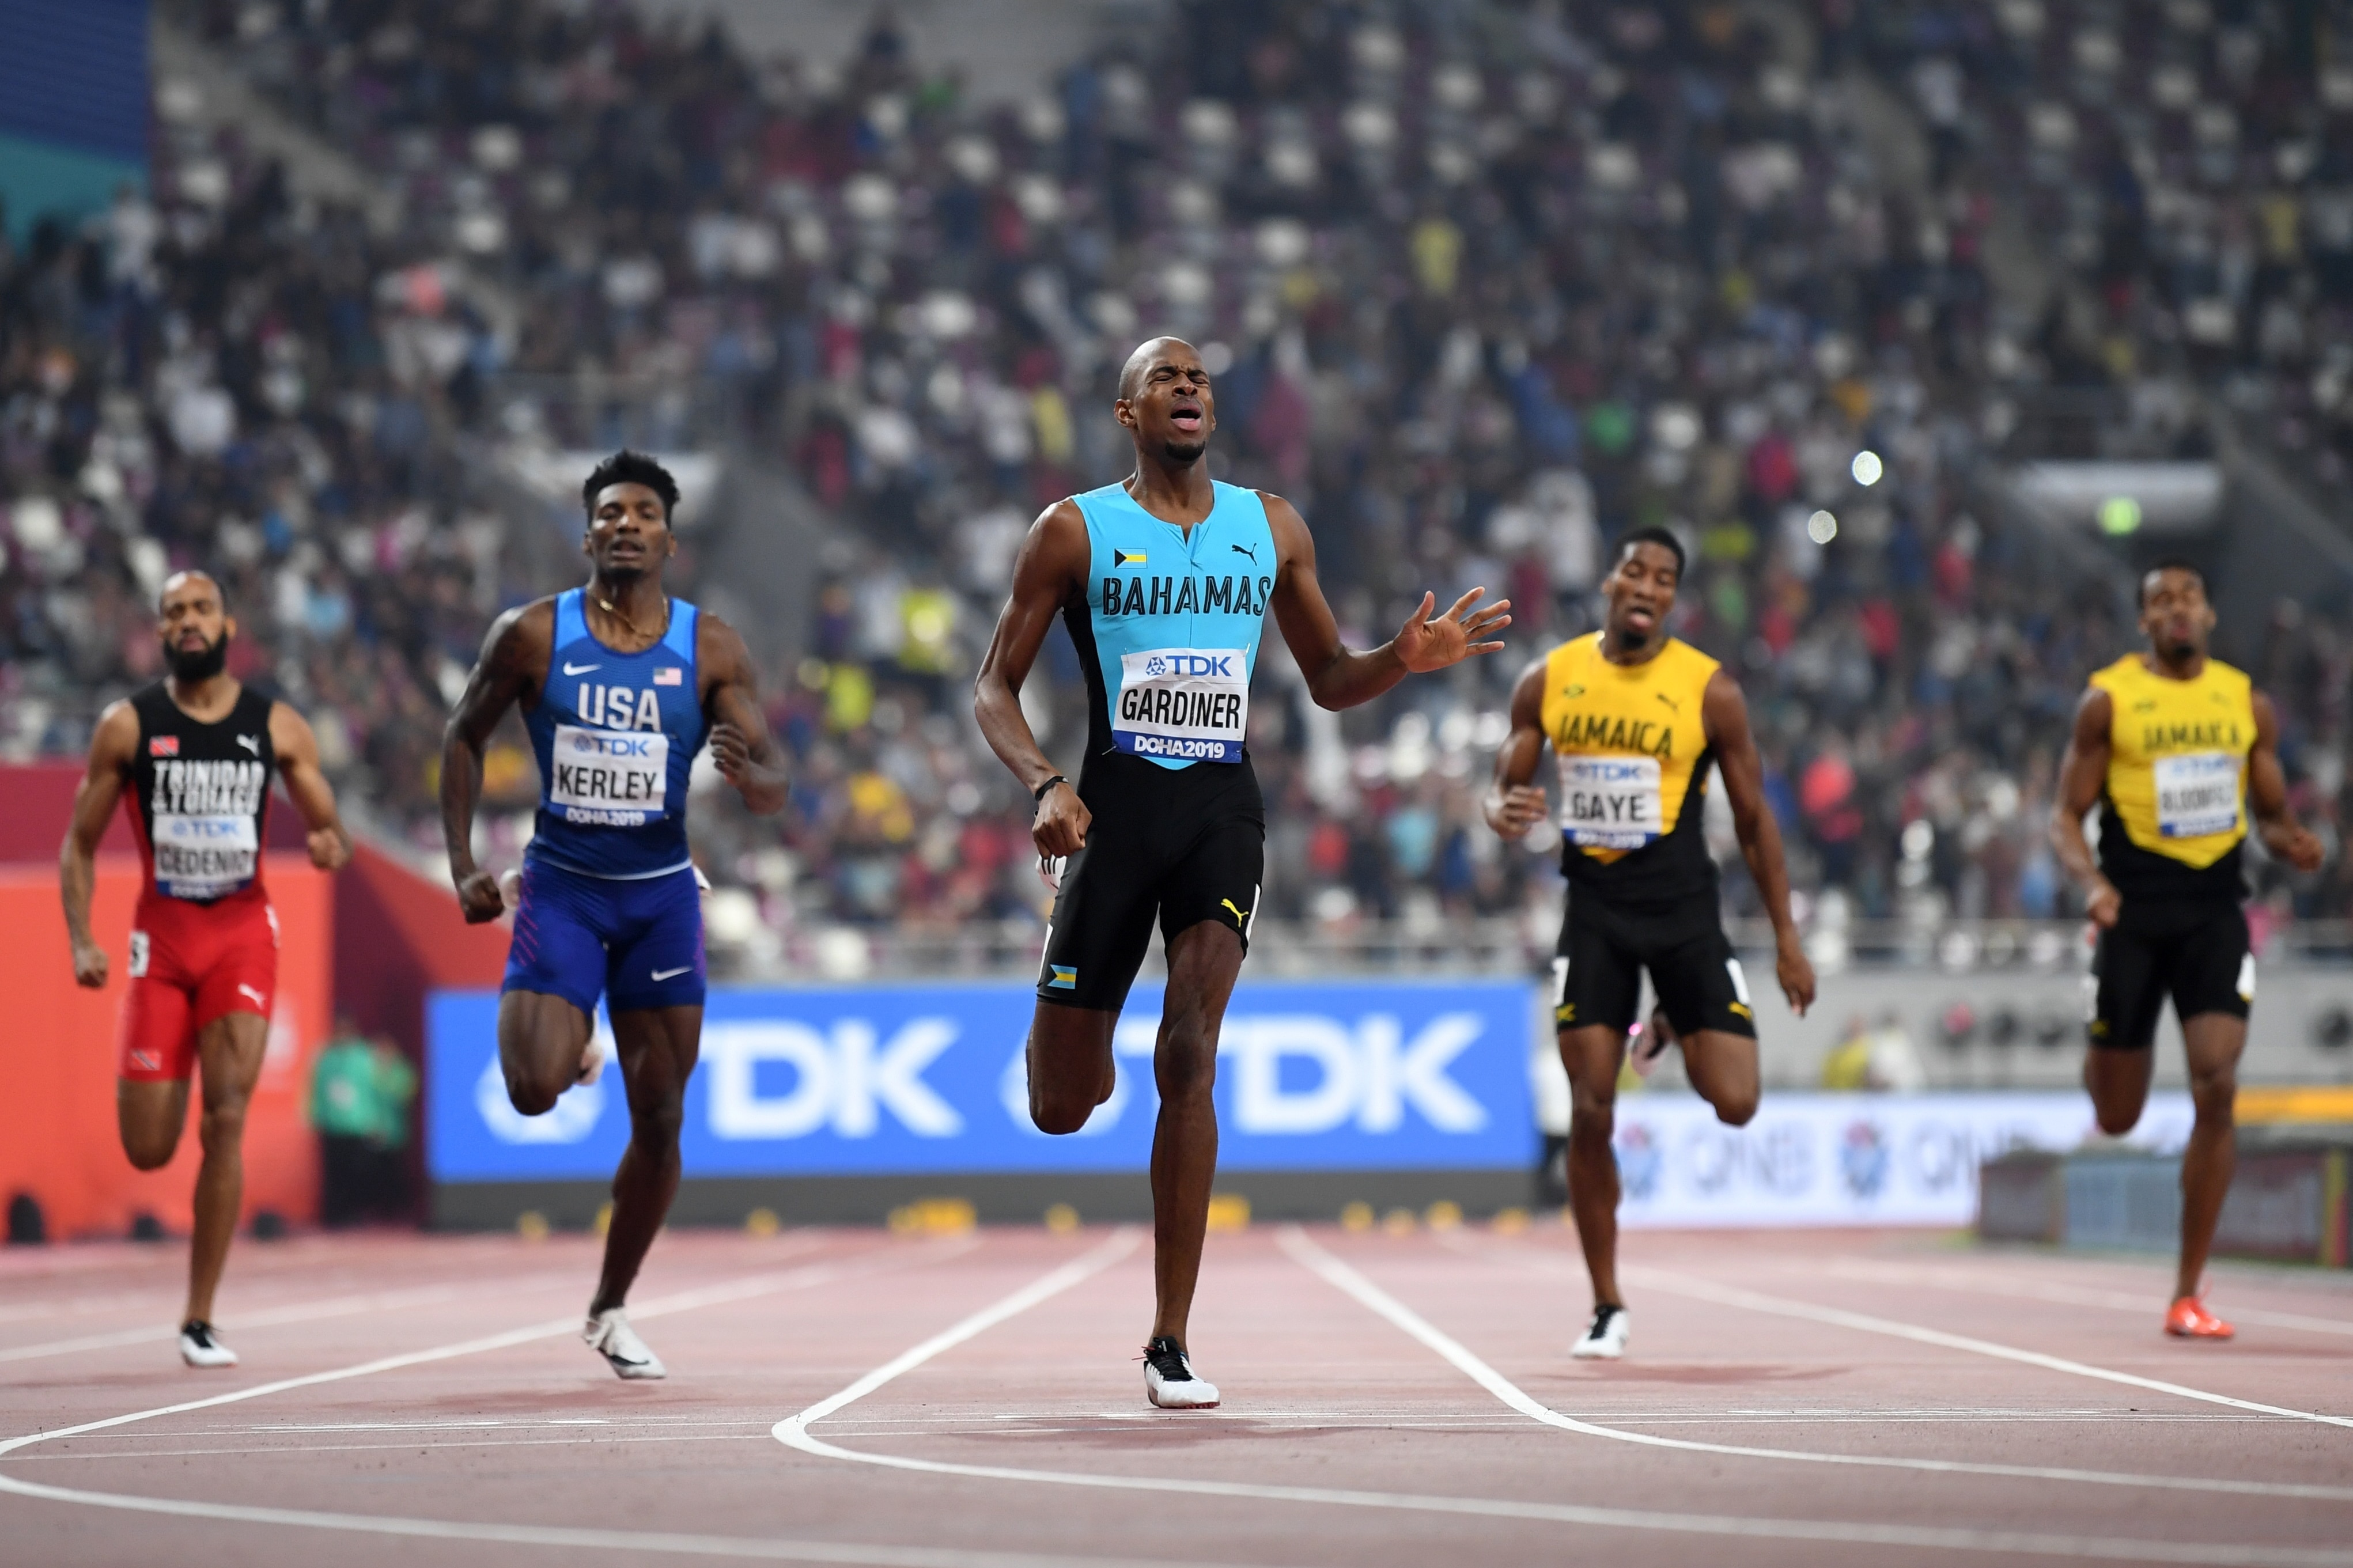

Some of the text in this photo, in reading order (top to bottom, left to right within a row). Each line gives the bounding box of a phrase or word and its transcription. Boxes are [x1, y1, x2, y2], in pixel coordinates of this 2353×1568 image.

[1102, 575, 1271, 616] BAHAMAS
[1166, 656, 1232, 677] TDK
[577, 682, 662, 733] USA
[1121, 688, 1240, 729] GARDINER
[593, 738, 649, 757] TDK
[1134, 735, 1225, 759] DOHA2019
[1559, 715, 1673, 759] JAMAICA
[153, 760, 265, 793] TRINIDAD
[558, 763, 657, 801] KERLEY
[1590, 763, 1640, 781] TDK
[1572, 791, 1647, 822] GAYE
[191, 820, 239, 838] TDK
